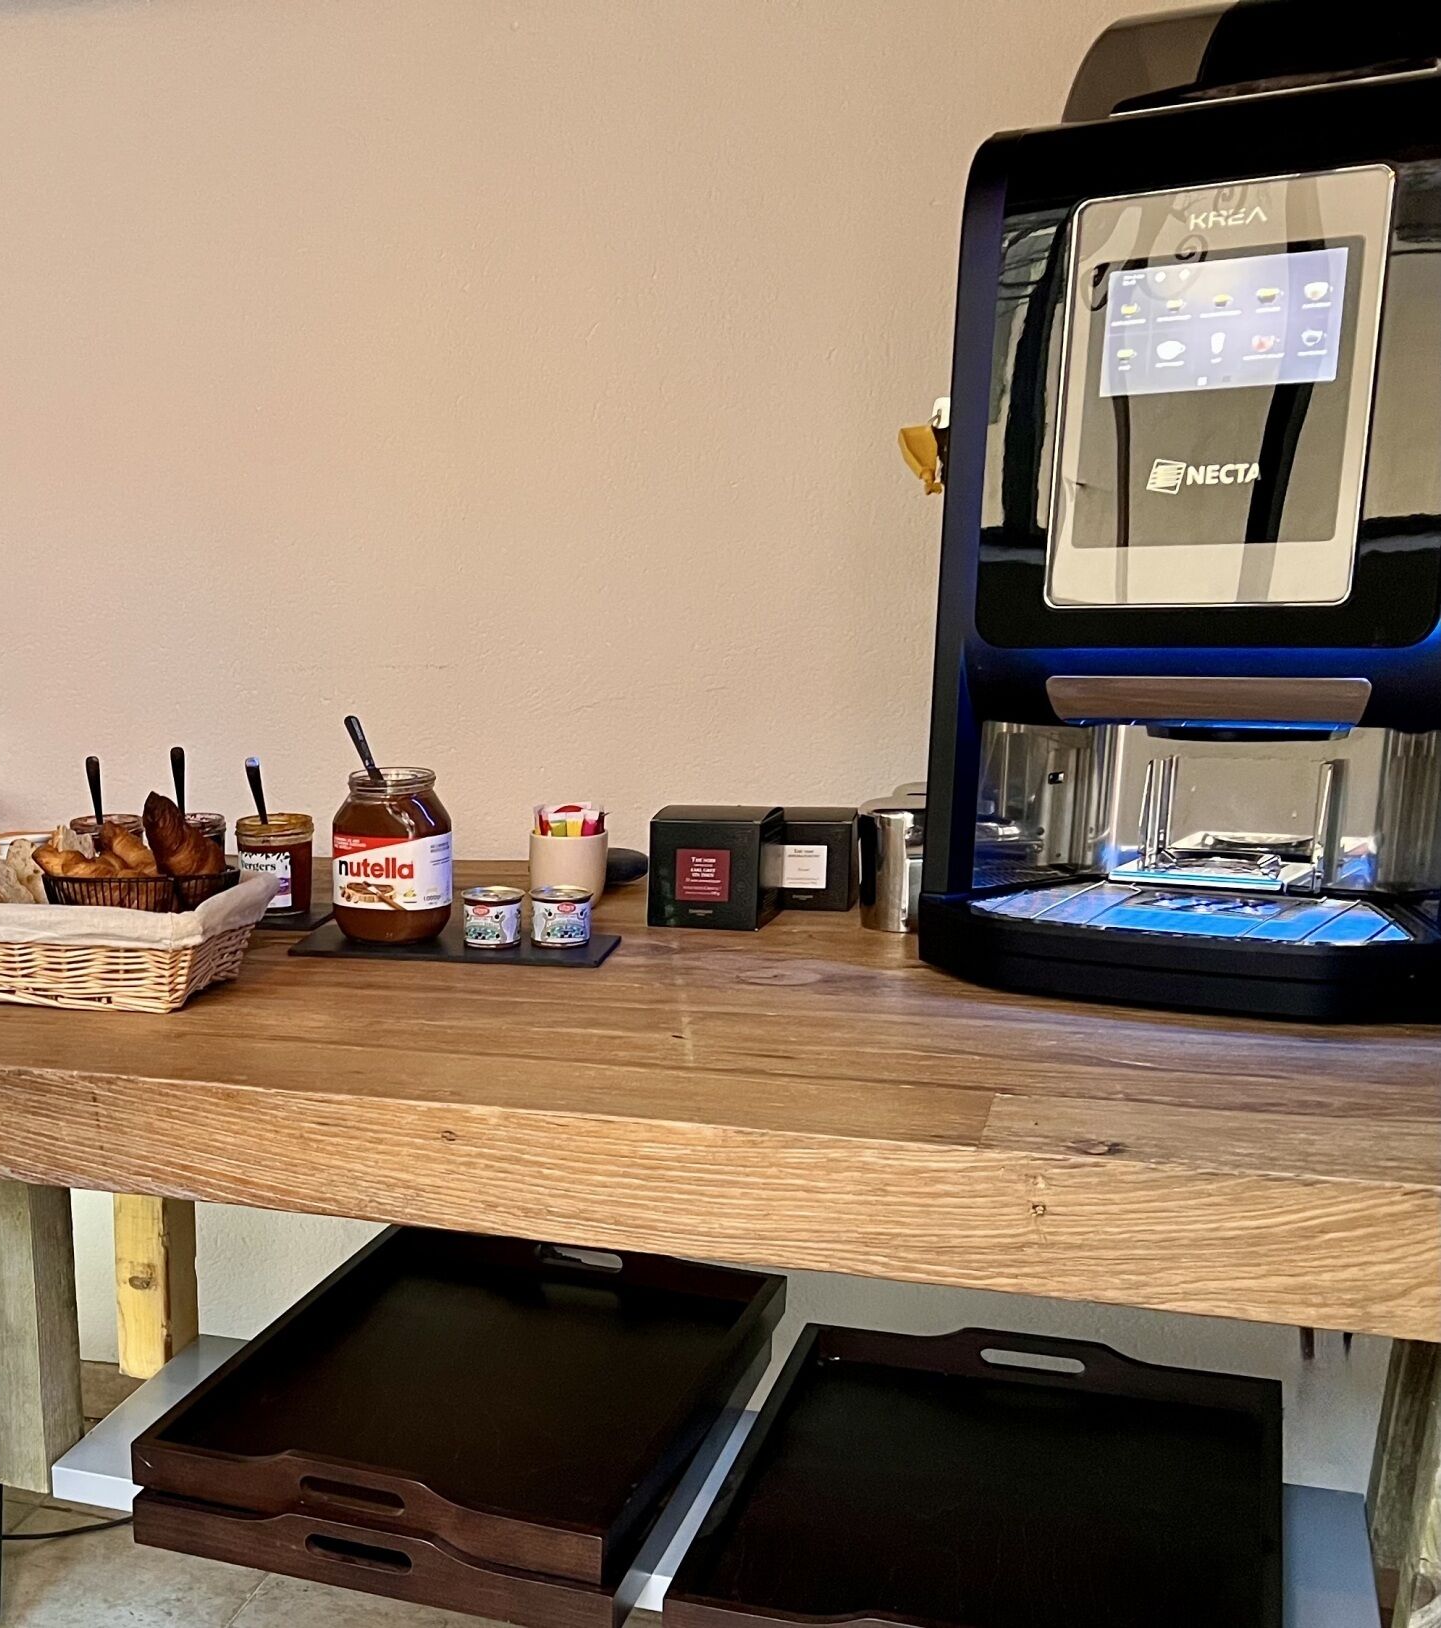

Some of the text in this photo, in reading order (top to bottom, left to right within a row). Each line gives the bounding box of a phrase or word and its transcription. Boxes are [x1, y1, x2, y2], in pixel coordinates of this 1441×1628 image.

[1189, 206, 1268, 231] KREA
[1186, 462, 1261, 485] NECTA
[338, 857, 414, 879] nutella
